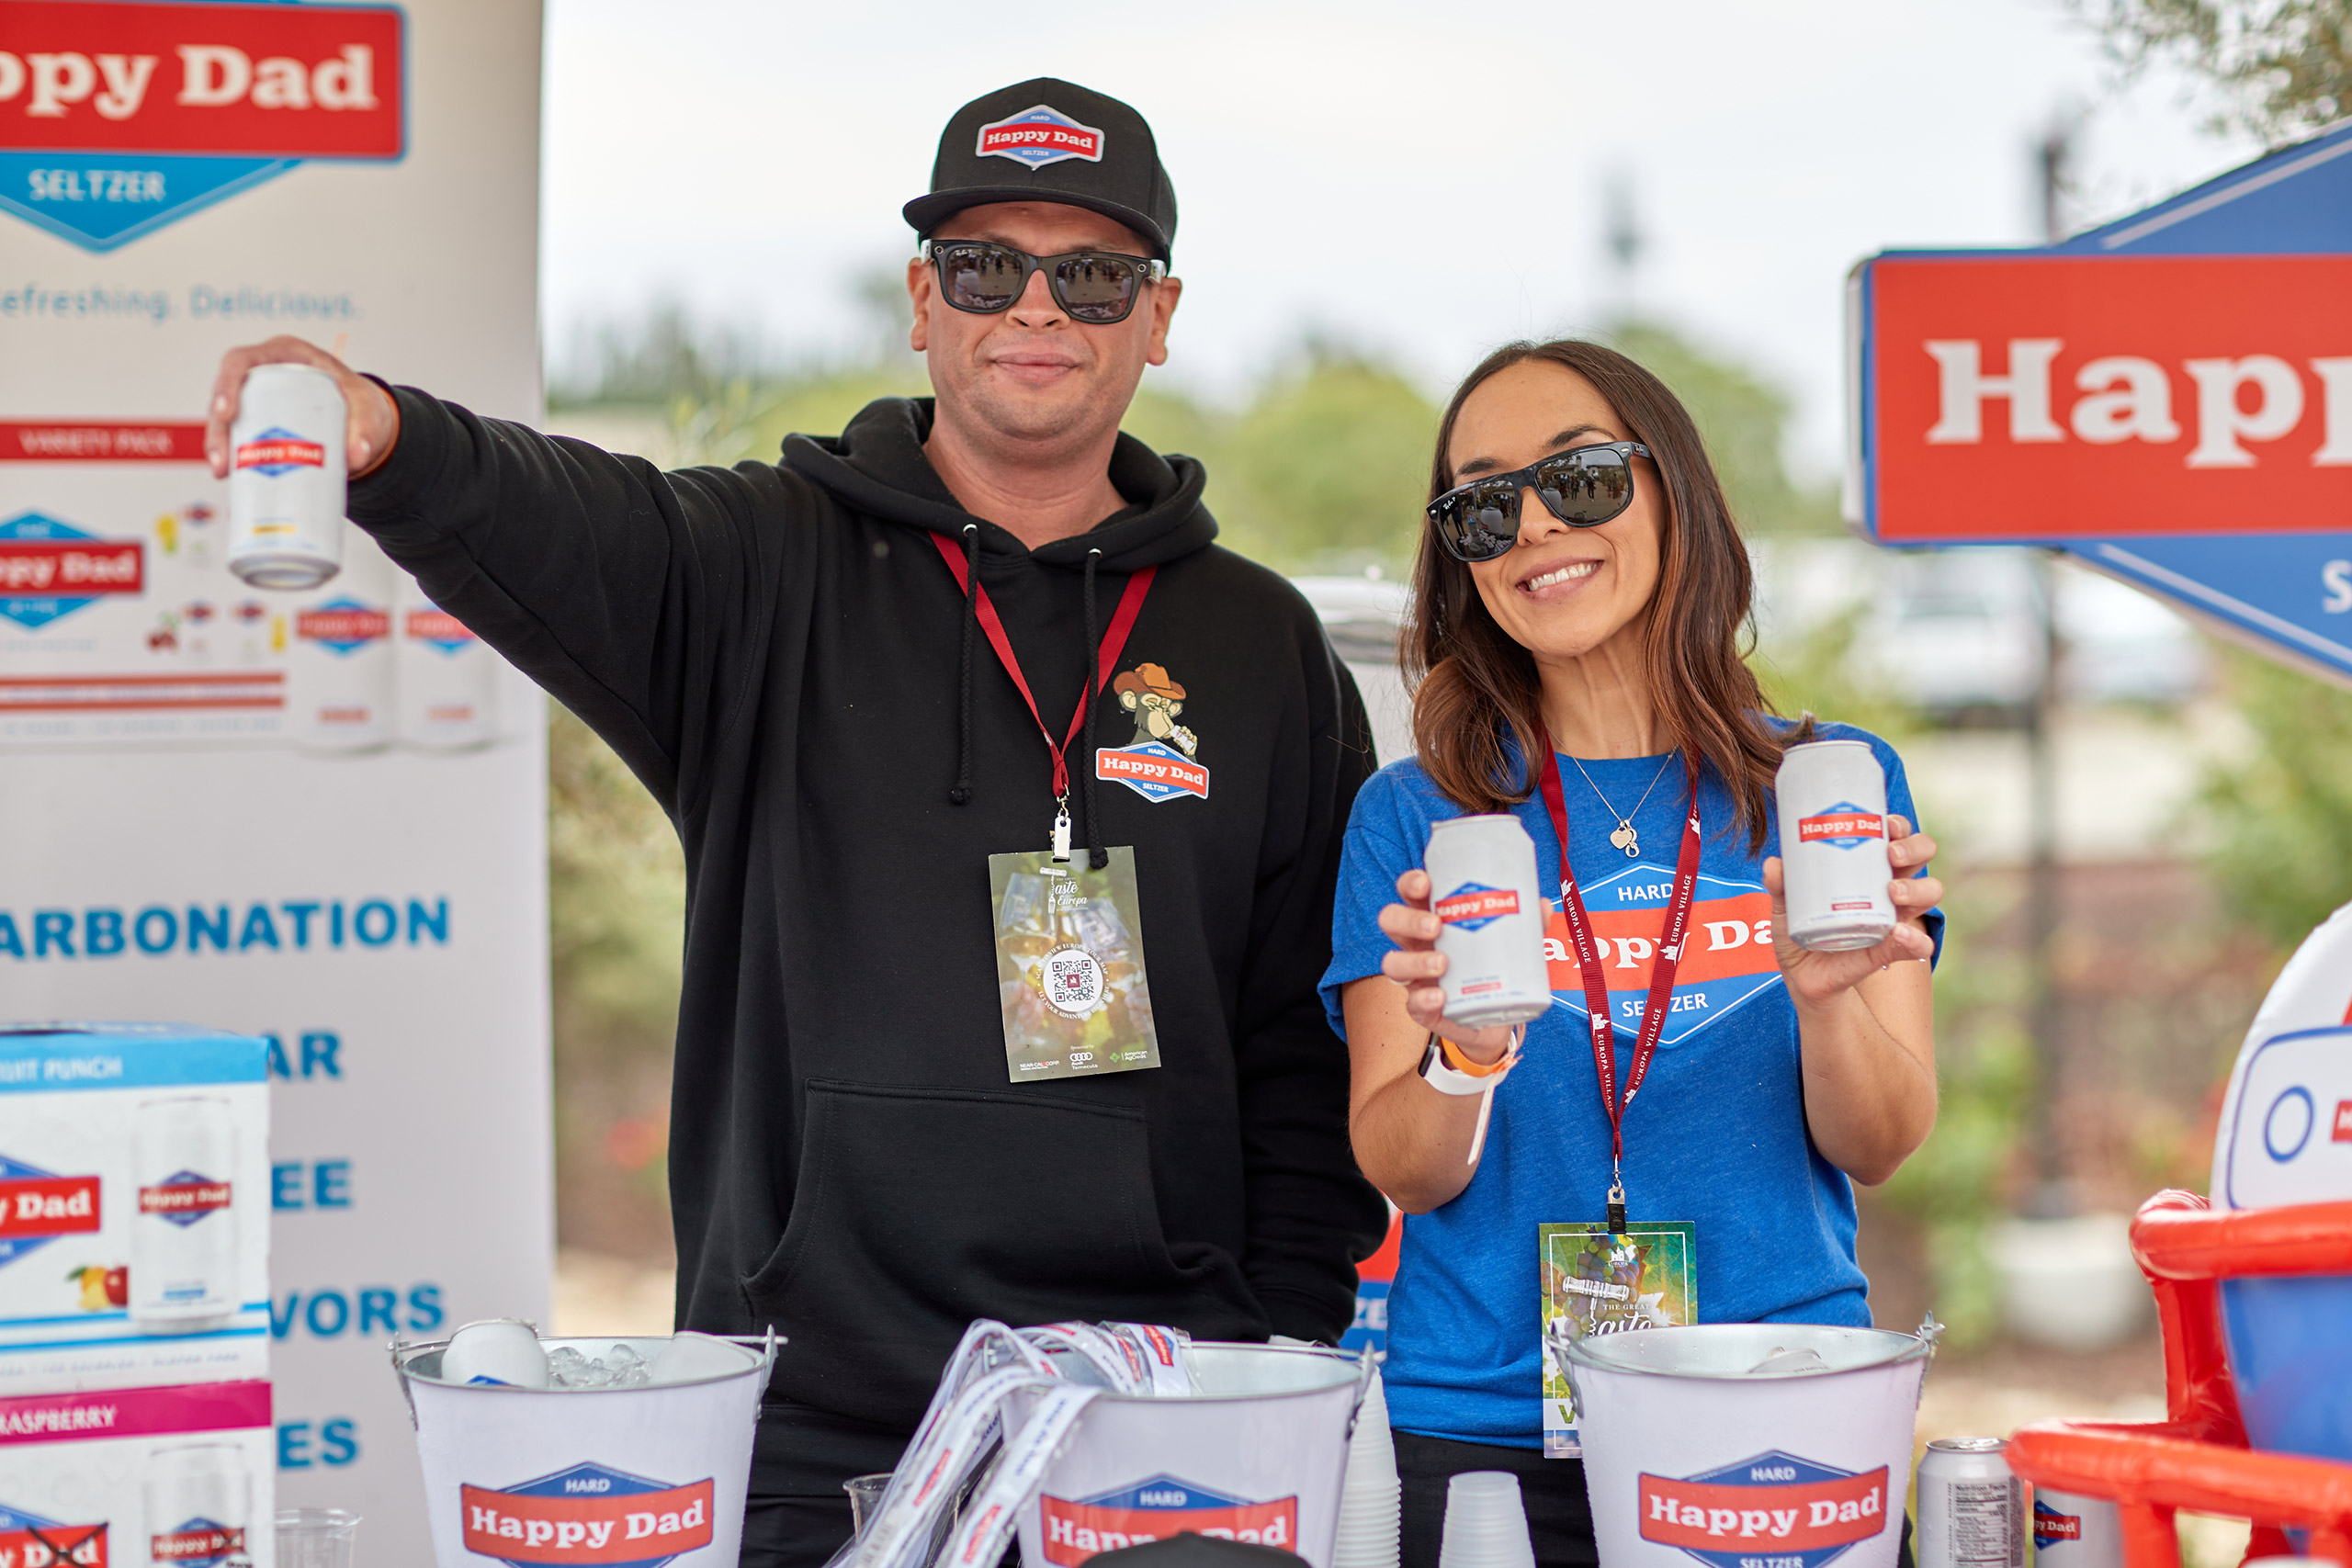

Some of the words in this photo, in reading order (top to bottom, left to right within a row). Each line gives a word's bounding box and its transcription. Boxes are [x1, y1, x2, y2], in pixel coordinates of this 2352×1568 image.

[176, 43, 379, 111] Dad
[987, 130, 1050, 145] Happy
[1053, 131, 1093, 149] Dad
[28, 169, 165, 203] SELTZER
[2322, 559, 2352, 614] S
[1148, 748, 1166, 756] HARD
[1103, 757, 1168, 778] Happy
[1170, 766, 1204, 786] Dad
[1142, 783, 1169, 793] SELTZER
[1802, 821, 1855, 835] Happy
[1857, 818, 1882, 831] Dad
[1057, 895, 1088, 907] Europa
[1436, 901, 1482, 917] Happy
[1484, 895, 1516, 909] Dad
[1618, 883, 1673, 901] HARD
[1670, 912, 1684, 942] EUROPA
[1678, 874, 1692, 909] VILLAGE
[0, 896, 450, 961] ARBONATION
[1566, 896, 1579, 927] EUROPA
[1576, 928, 1591, 963] VILLAGE
[1086, 945, 1103, 961] TOUR
[1544, 931, 1690, 969] app
[1702, 919, 1773, 952] Da
[1043, 999, 1059, 1014] YOUR
[1622, 993, 1709, 1017] SEZER
[1597, 1034, 1609, 1070] EUROPA
[1634, 1050, 1649, 1086] EUROPA
[1645, 1008, 1661, 1047] VILLAGE
[43, 1055, 123, 1081] PUNCH
[272, 1160, 353, 1212] EE
[16, 1188, 92, 1221] Dad
[269, 1283, 446, 1339] VORS
[0, 1404, 118, 1436] RASPBERRY
[277, 1418, 359, 1471] ES
[565, 1478, 612, 1493] HARD
[1750, 1467, 1796, 1482] HARD
[1140, 1490, 1187, 1506] HARD
[1649, 1494, 1800, 1538] Happy
[1807, 1486, 1881, 1528] Dad
[470, 1506, 616, 1549] Happy
[625, 1498, 705, 1540] Dad
[1048, 1516, 1158, 1553] Hap
[2047, 1520, 2076, 1533] Dad
[210, 1533, 243, 1550] Dd
